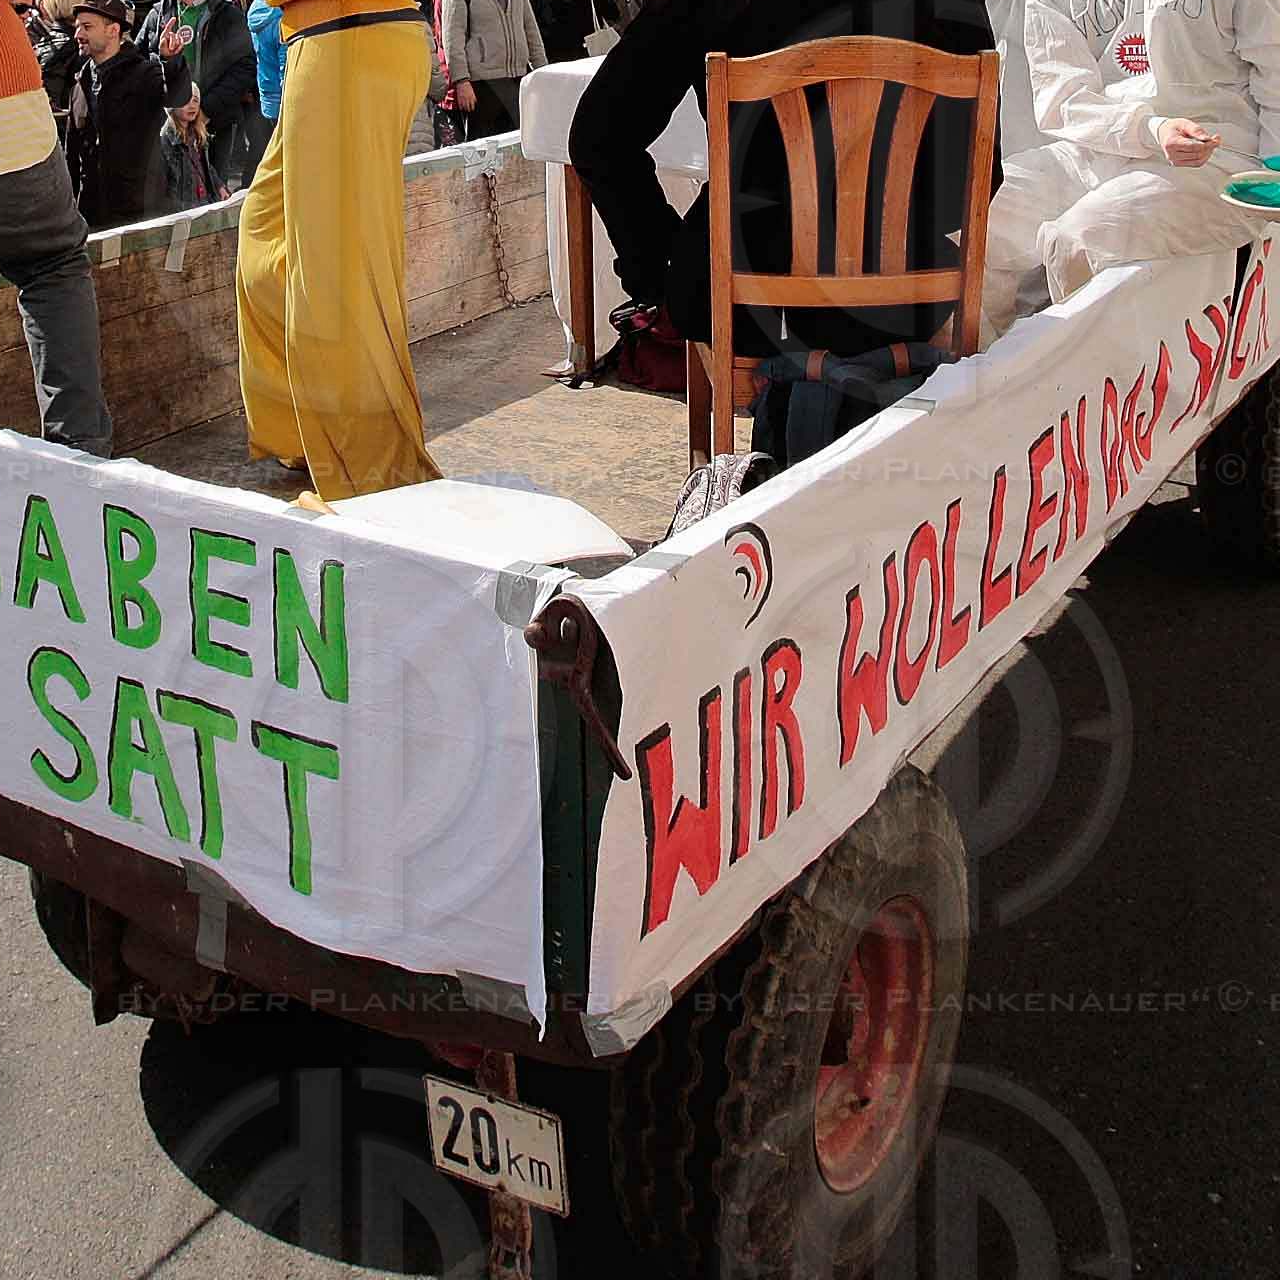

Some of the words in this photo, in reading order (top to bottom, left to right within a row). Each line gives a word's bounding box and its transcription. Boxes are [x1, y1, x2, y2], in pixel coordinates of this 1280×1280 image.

[1122, 44, 1146, 55] TTI
[634, 637, 805, 943] WIR
[836, 394, 1088, 769] WOLLEN
[1100, 339, 1173, 515] DAS
[28, 645, 341, 897] SATT
